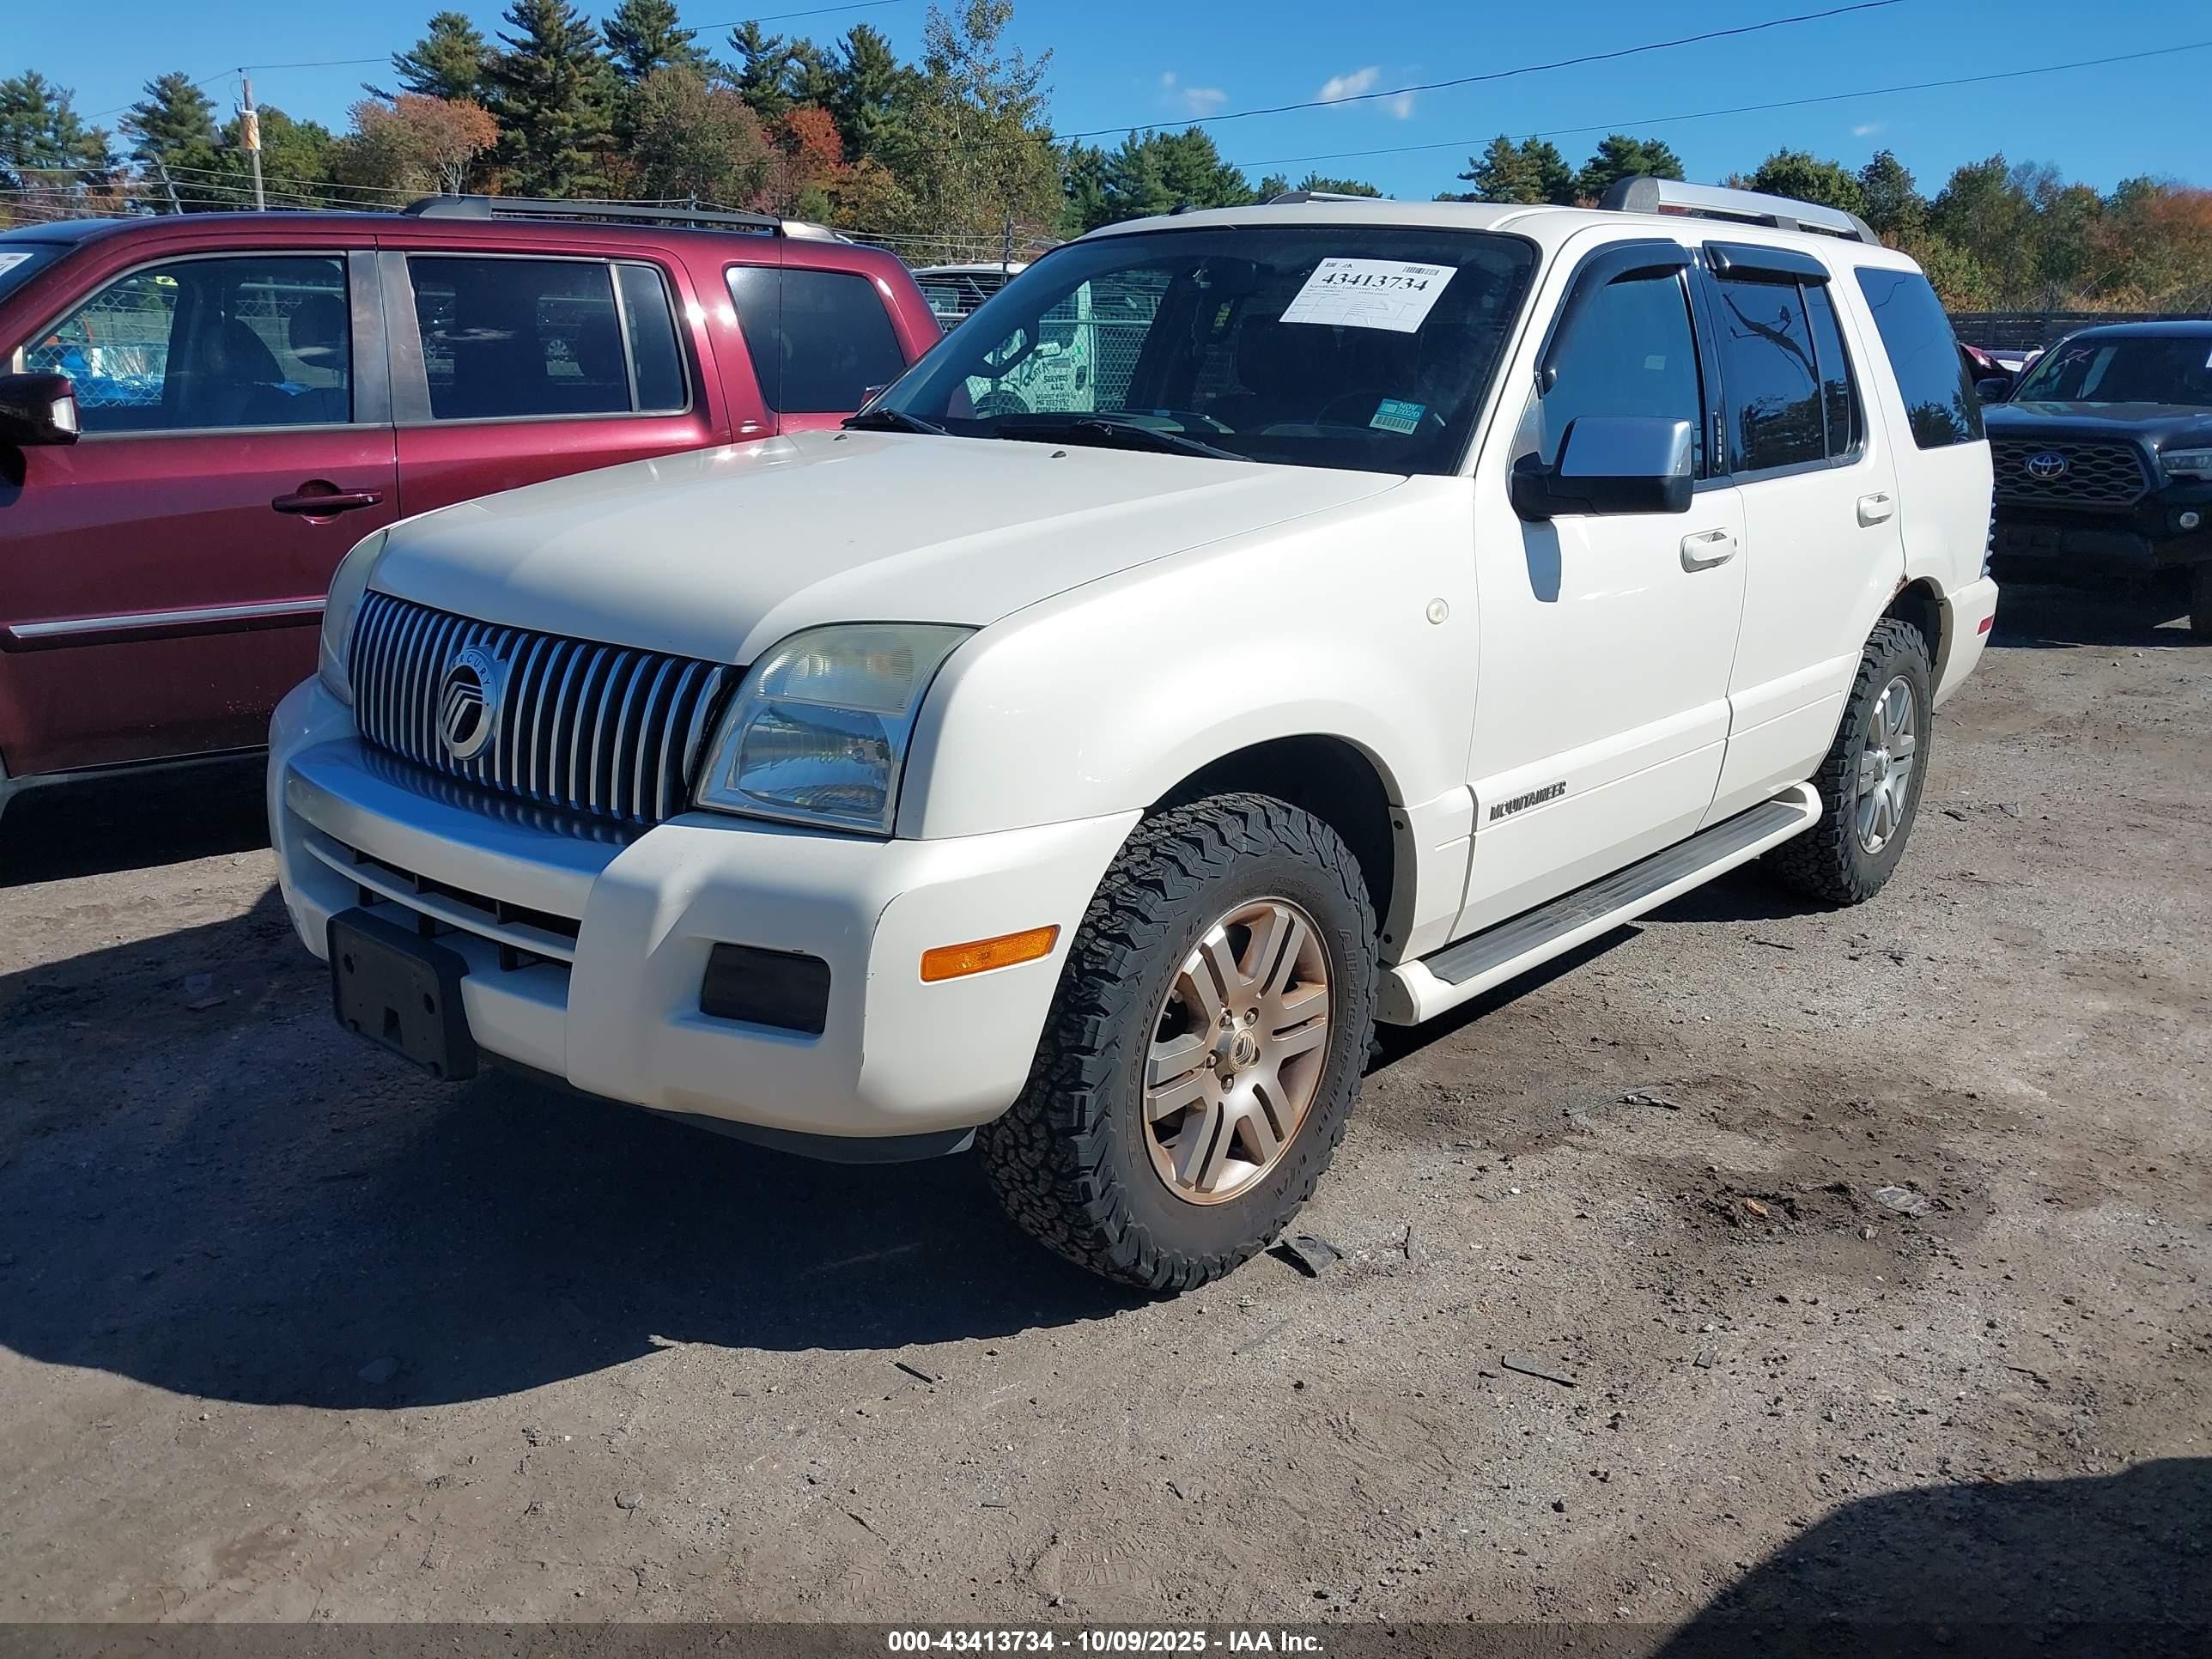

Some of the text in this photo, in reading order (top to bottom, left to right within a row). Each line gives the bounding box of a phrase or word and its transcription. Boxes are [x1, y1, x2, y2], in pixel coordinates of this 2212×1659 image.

[1322, 272, 1429, 291] 43413734
[1395, 408, 1420, 418] 2020
[1399, 402, 1418, 411] NOV
[1490, 780, 1566, 822] MOUNTAINEER
